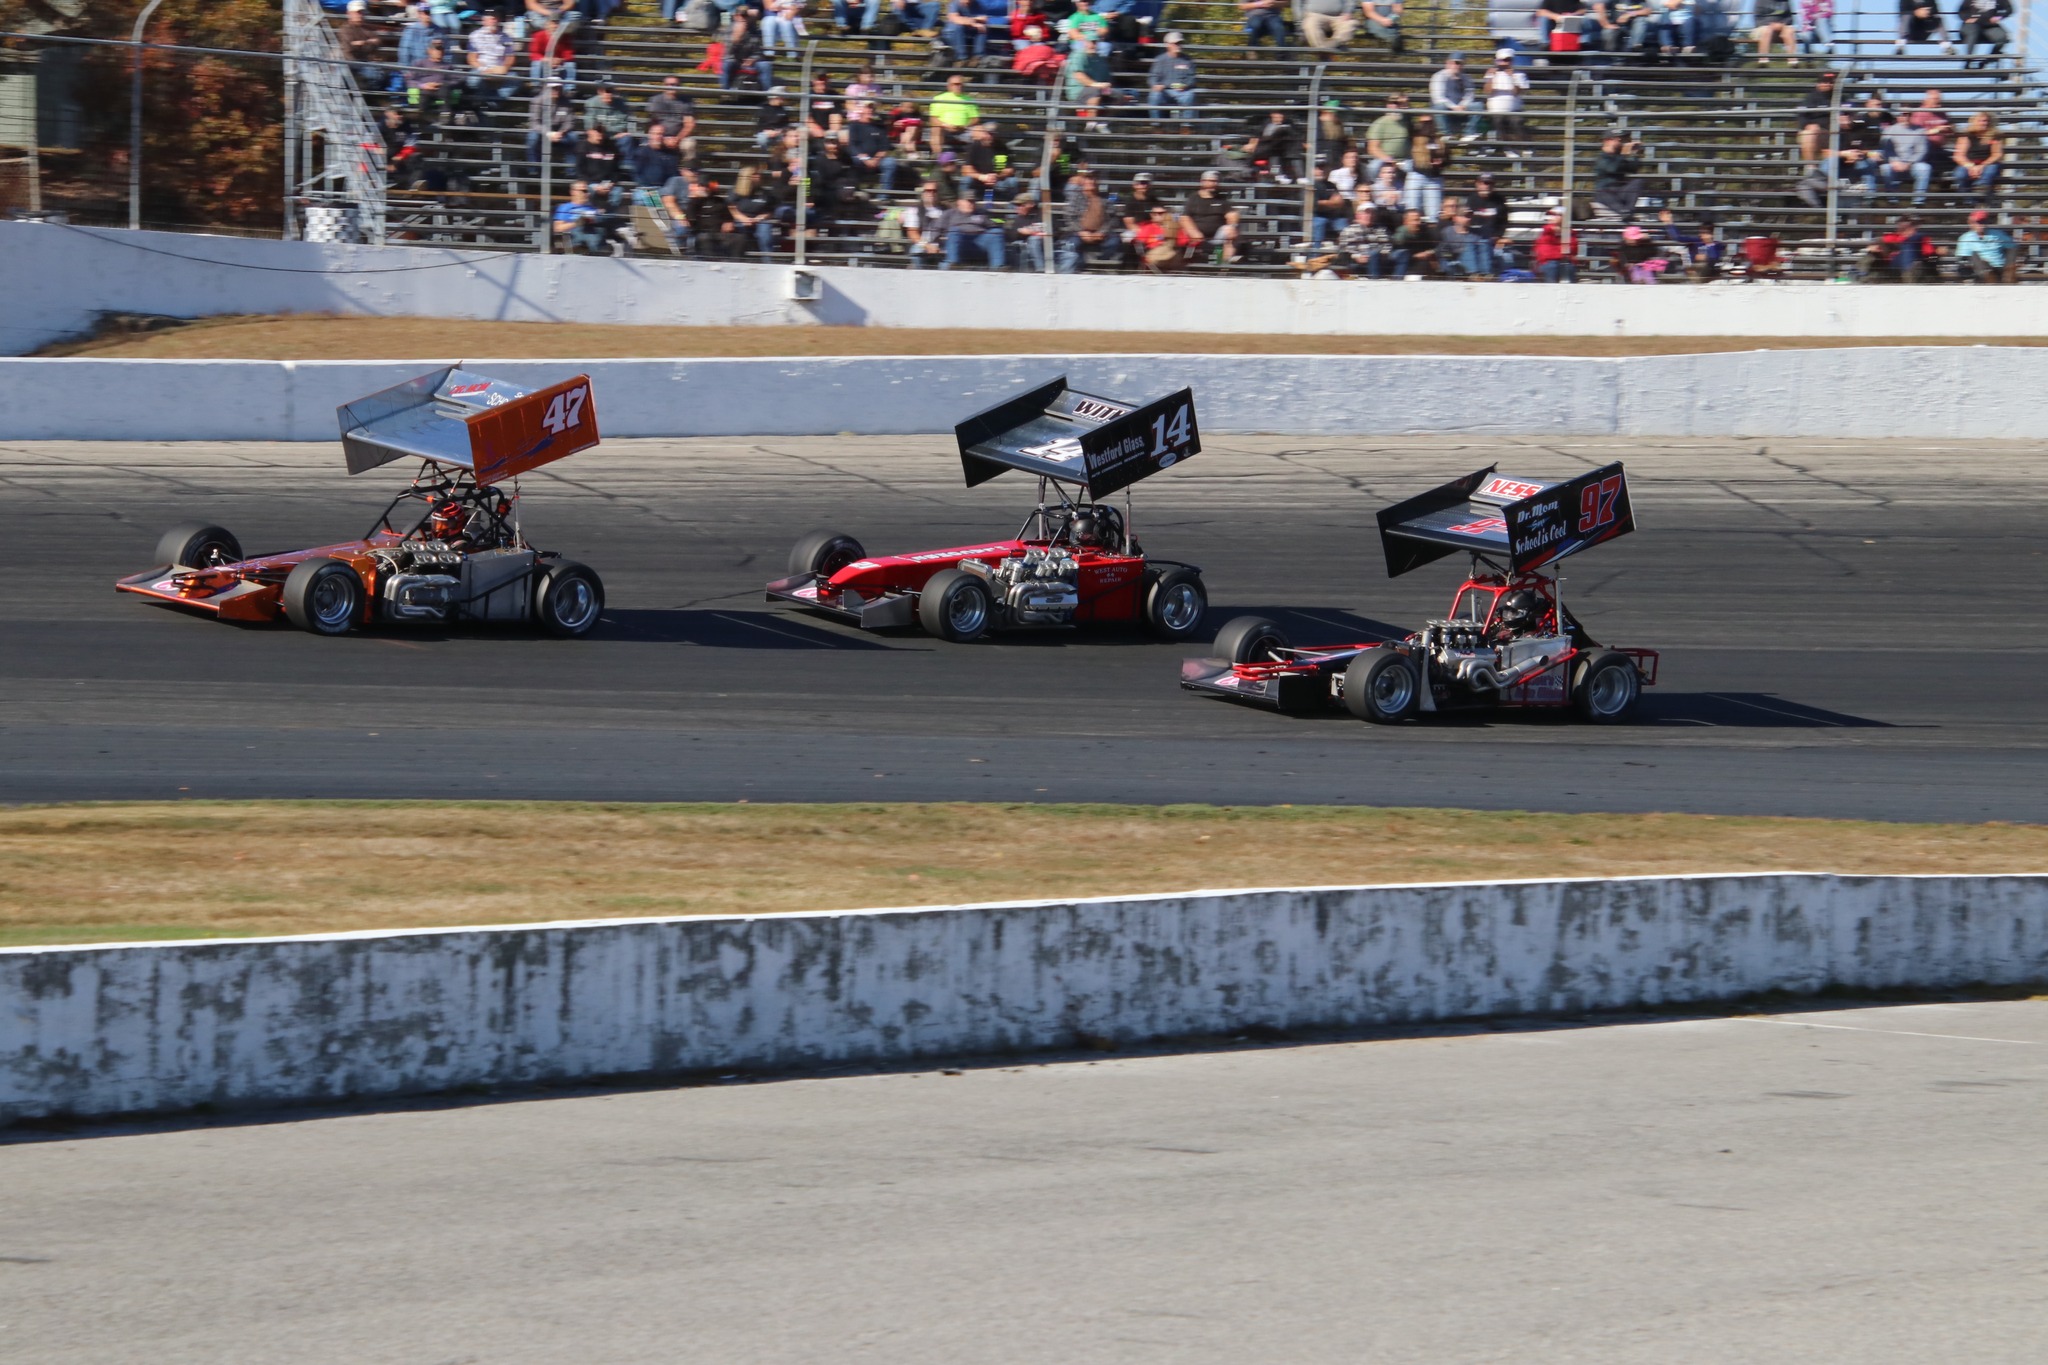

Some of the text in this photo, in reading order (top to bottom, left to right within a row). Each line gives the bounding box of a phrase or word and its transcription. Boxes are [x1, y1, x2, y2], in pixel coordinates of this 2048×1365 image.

[542, 384, 588, 435] 47
[1150, 404, 1192, 458] 14
[1087, 442, 1123, 470] Westford
[1483, 479, 1542, 500] NESS
[1579, 473, 1622, 533] 97
[1515, 520, 1567, 555] School is Cool
